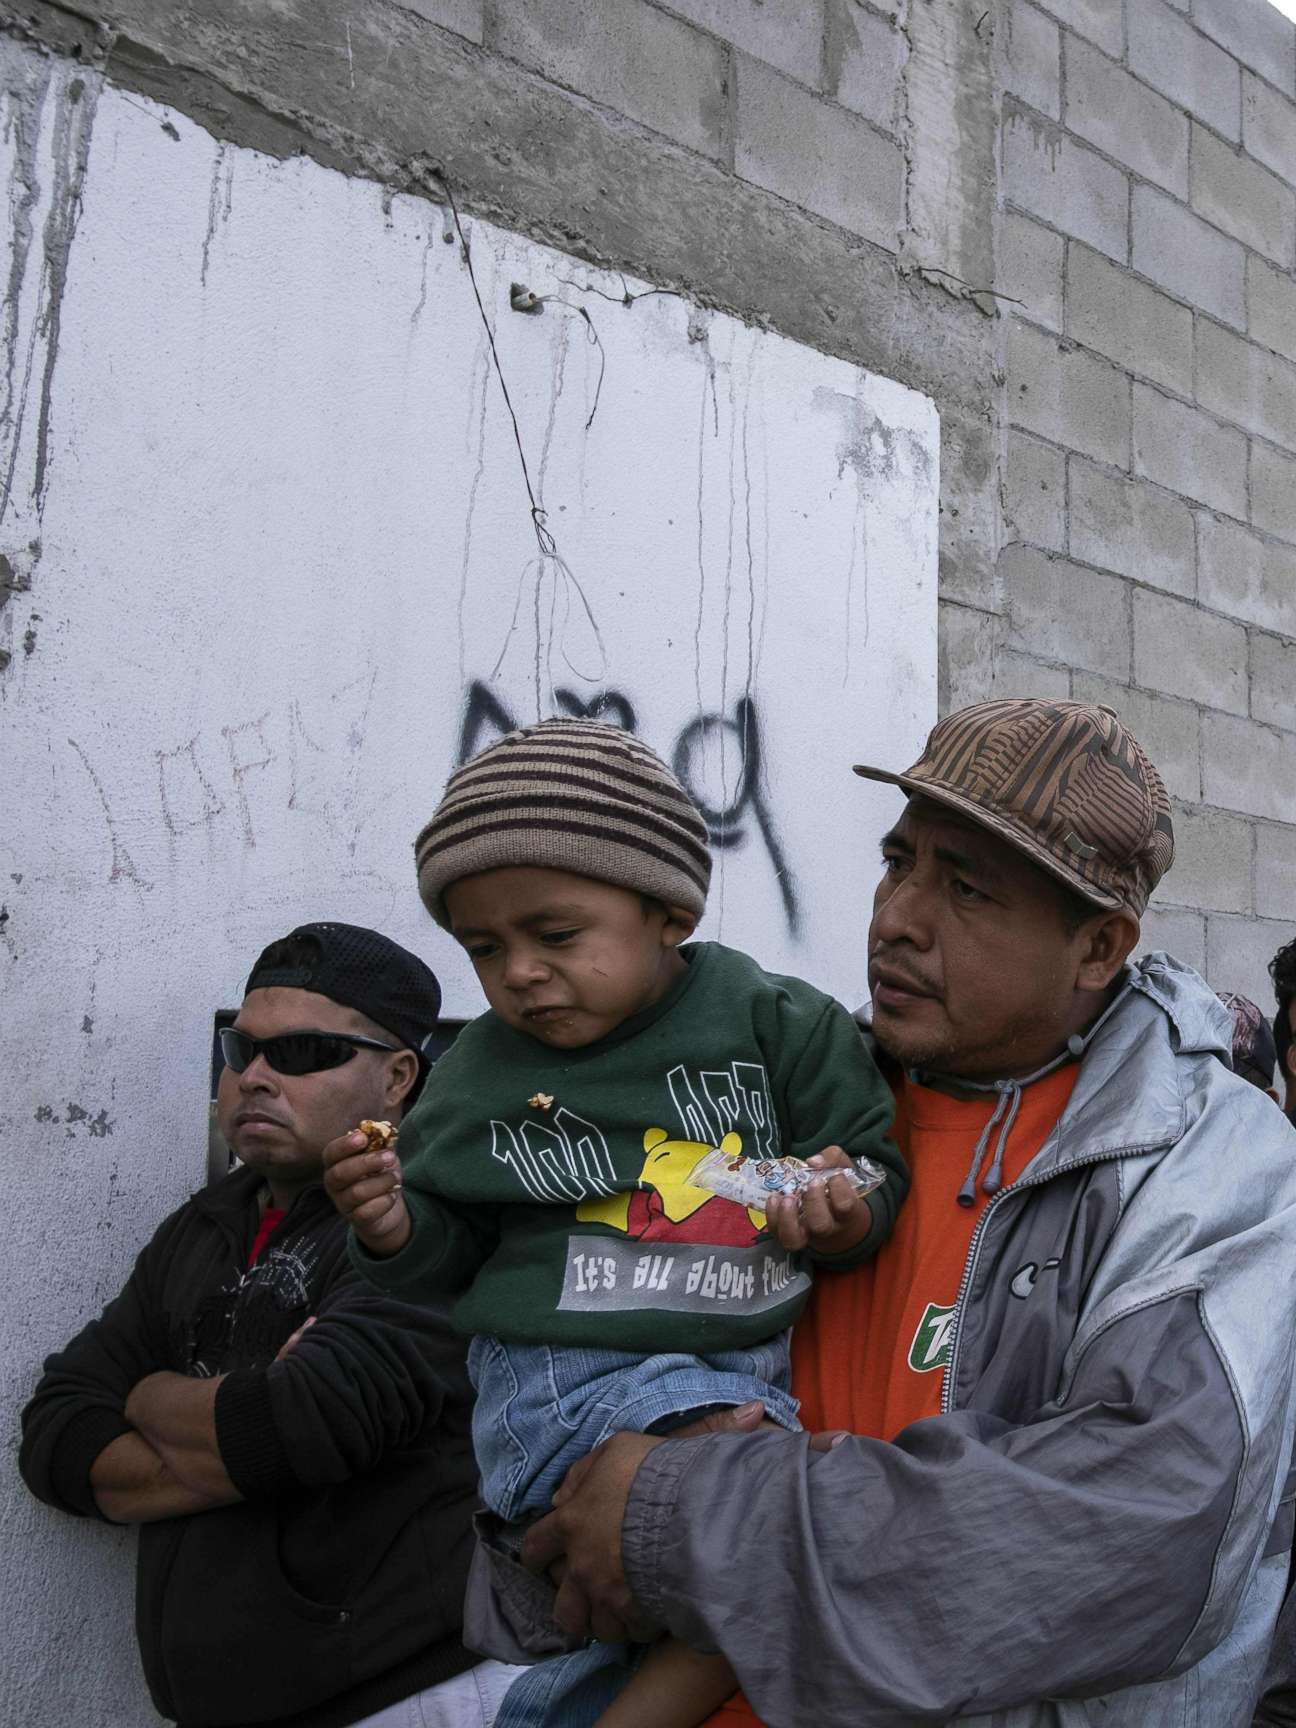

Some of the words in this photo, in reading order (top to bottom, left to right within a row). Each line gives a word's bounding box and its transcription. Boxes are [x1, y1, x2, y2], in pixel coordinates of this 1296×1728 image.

[573, 1253, 617, 1293] It's
[632, 1254, 675, 1291] all
[686, 1255, 754, 1300] about
